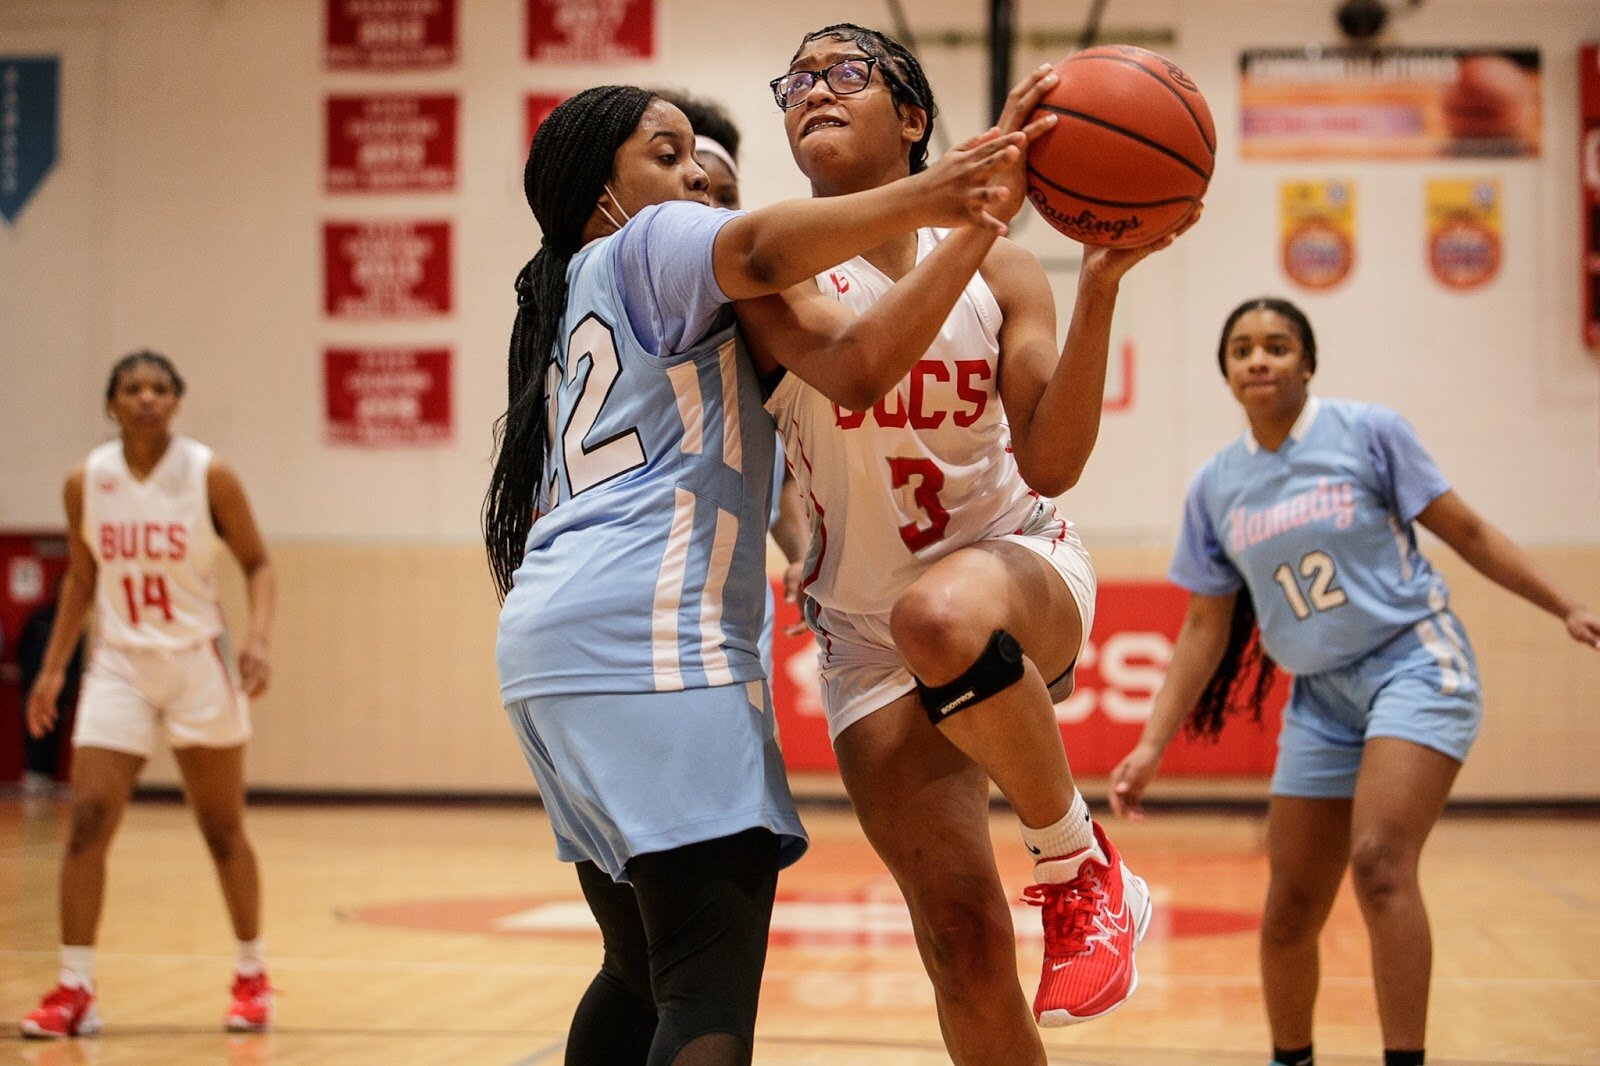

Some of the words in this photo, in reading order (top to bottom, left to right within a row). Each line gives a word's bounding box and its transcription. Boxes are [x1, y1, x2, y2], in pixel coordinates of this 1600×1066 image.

[1027, 185, 1140, 240] Rawlings
[885, 456, 951, 552] 3
[99, 521, 187, 562] BUCS
[121, 572, 174, 628] 14
[1272, 549, 1348, 621] 12
